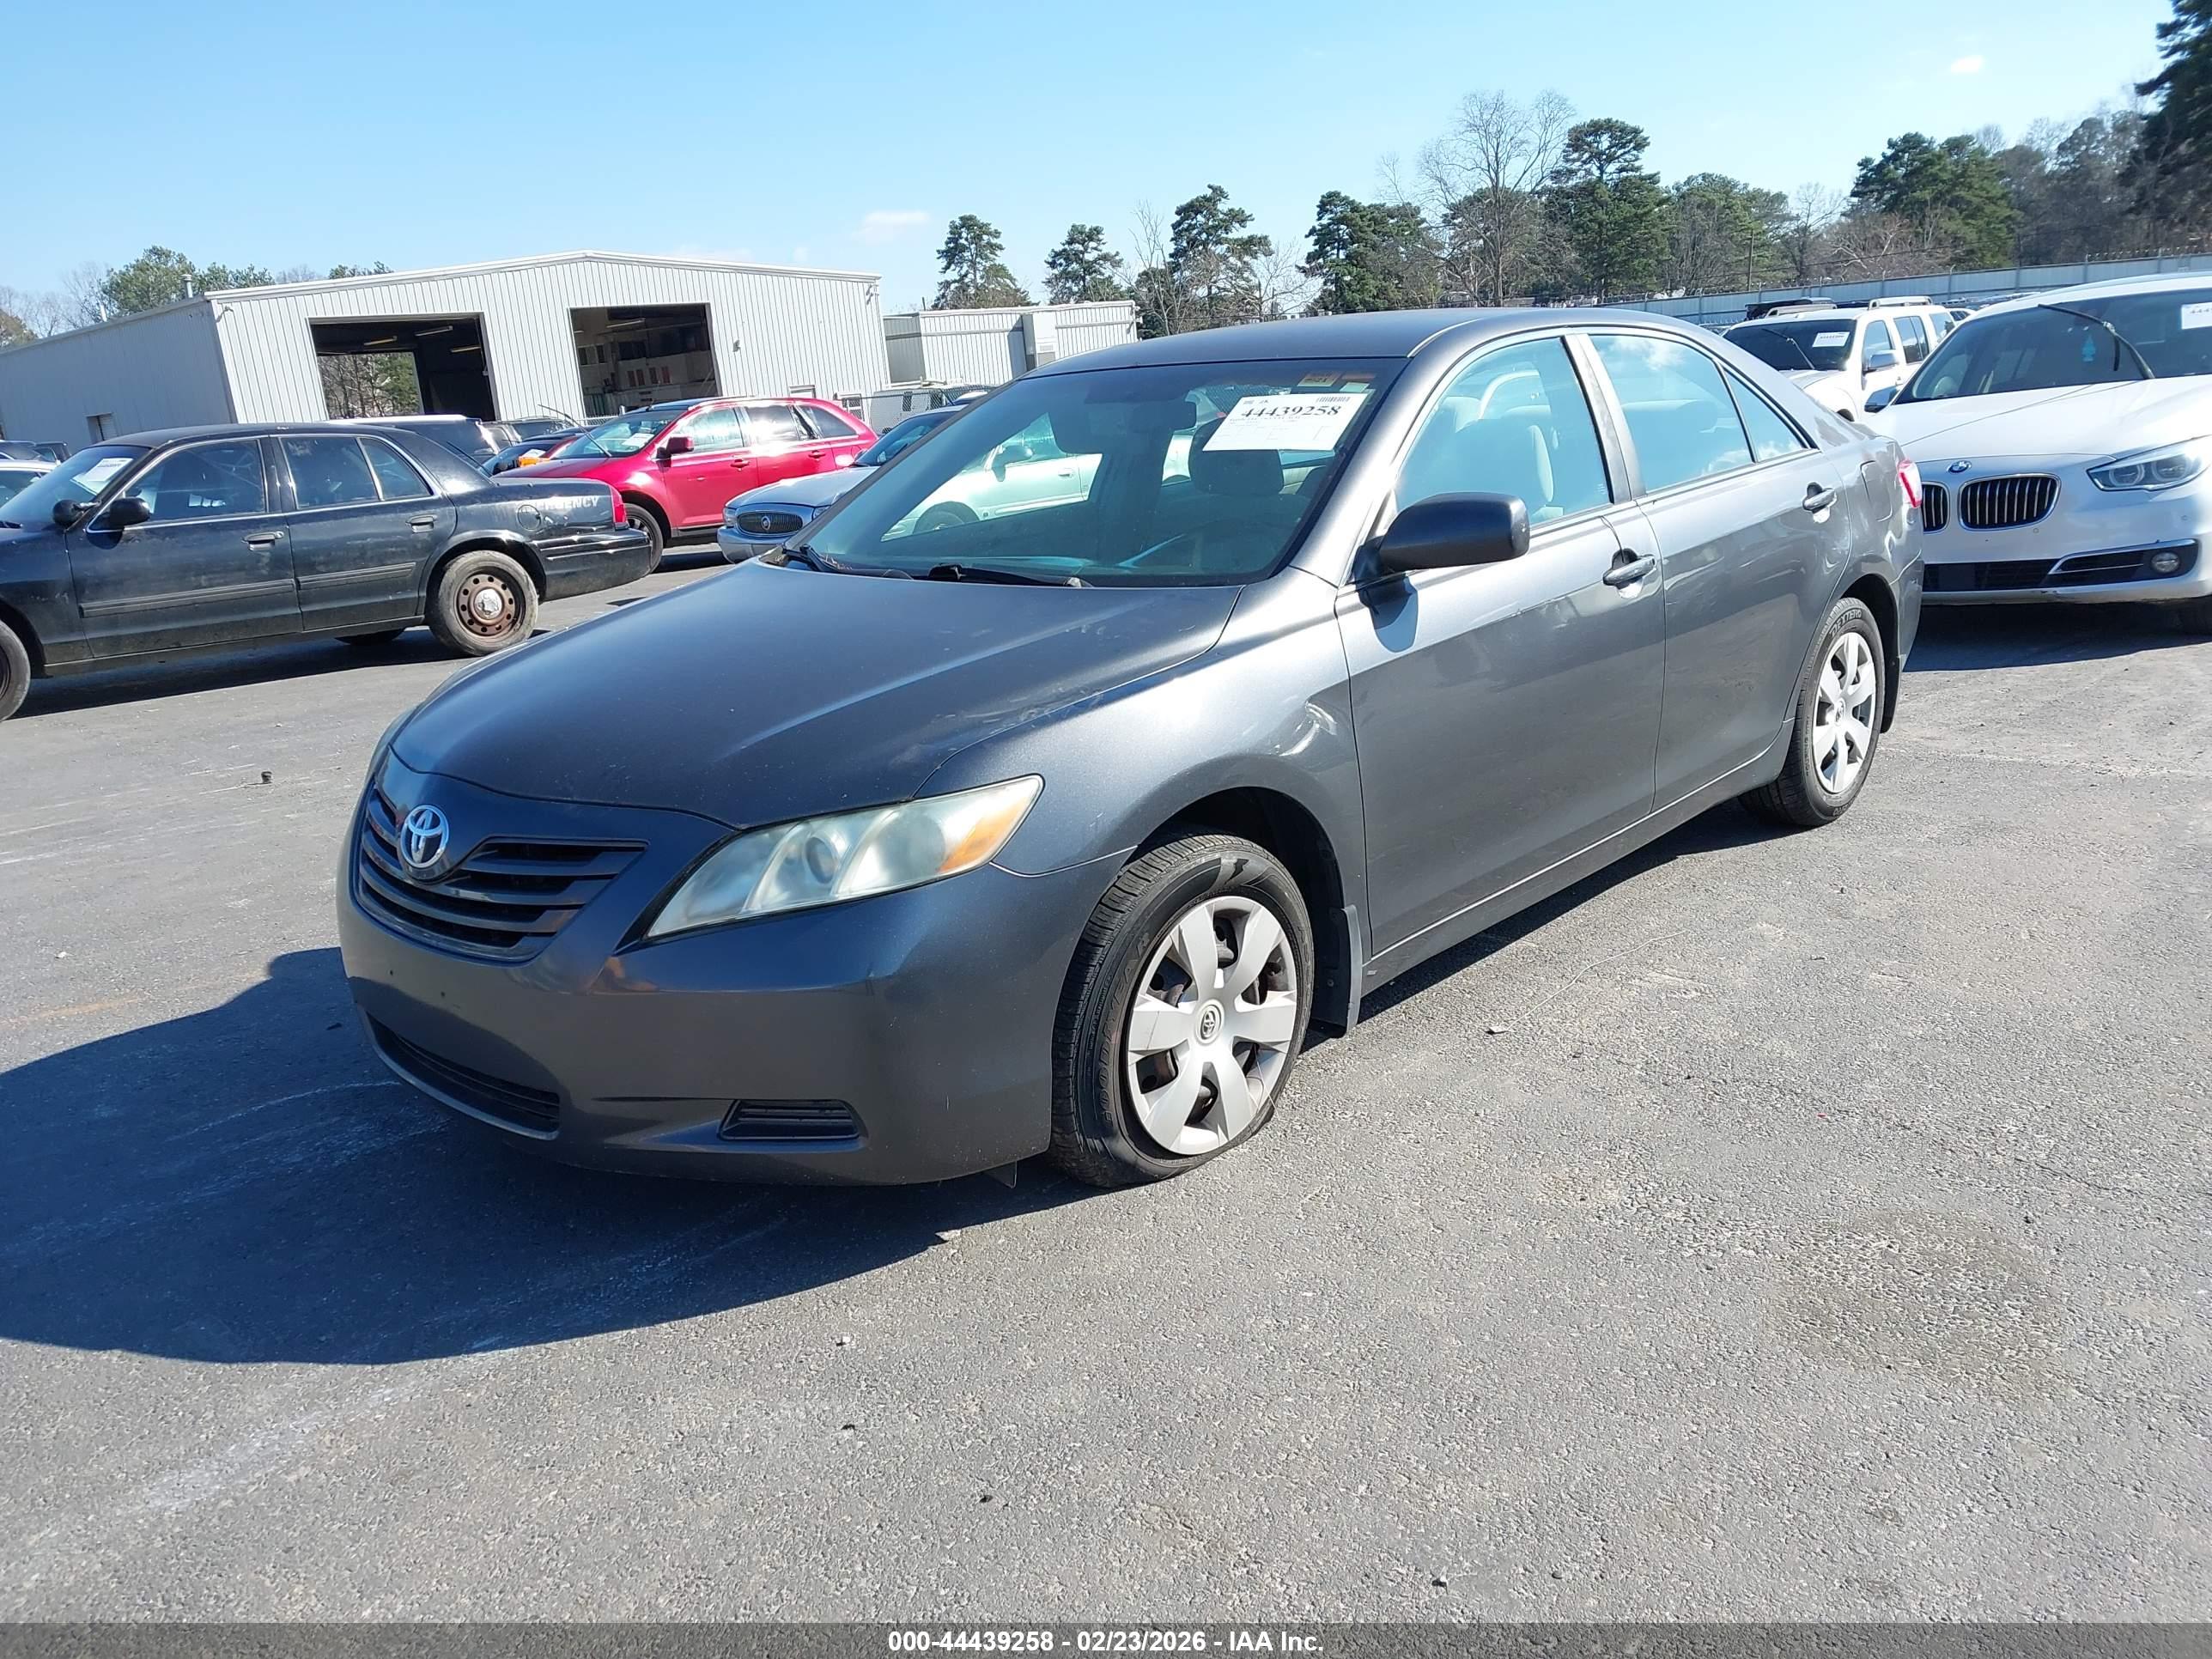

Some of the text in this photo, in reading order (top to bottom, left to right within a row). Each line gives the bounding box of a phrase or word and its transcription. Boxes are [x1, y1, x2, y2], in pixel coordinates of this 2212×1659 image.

[1241, 405, 1341, 417] 44439258
[1829, 609, 1863, 637] DEXTERO
[1098, 933, 1150, 1127] GOODYEAR
